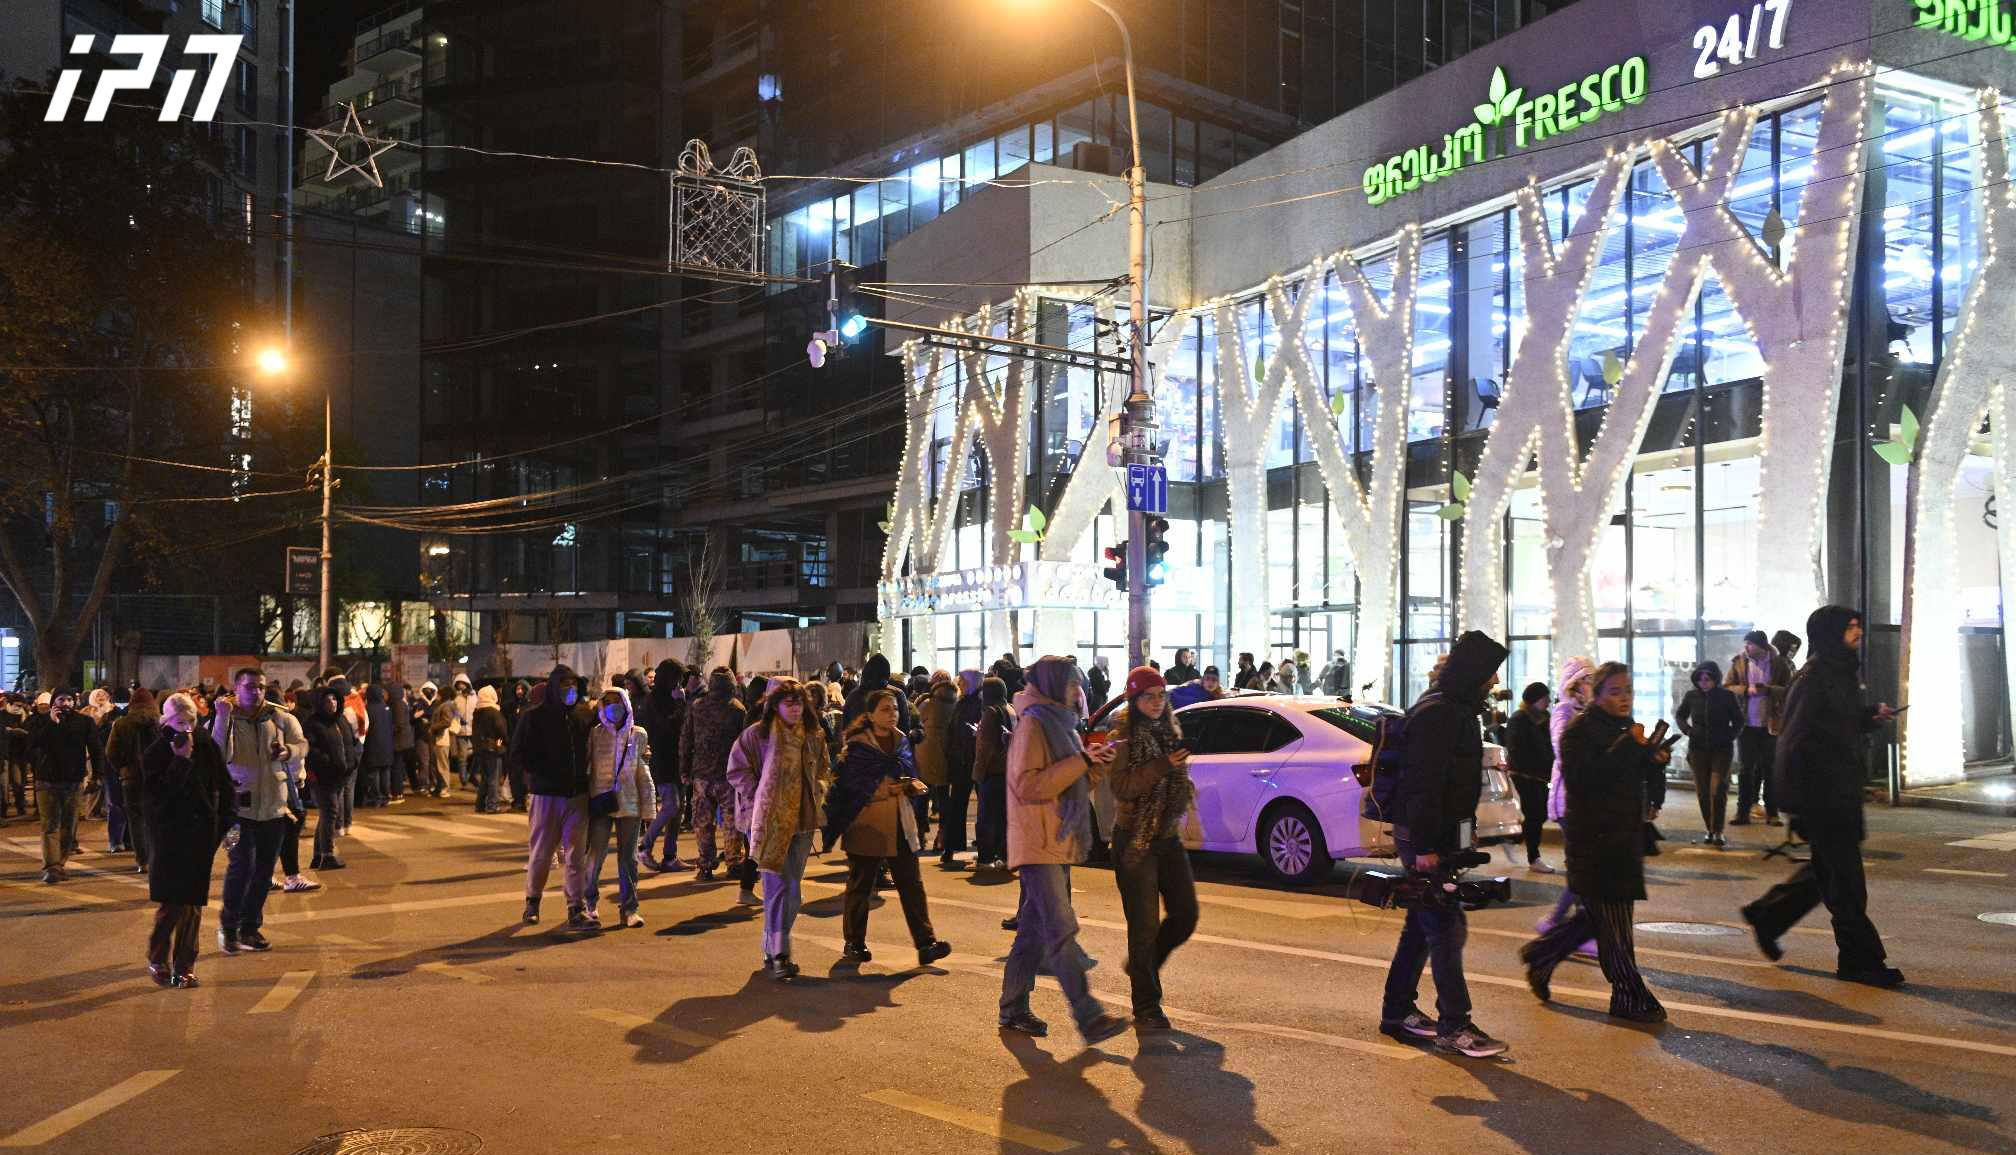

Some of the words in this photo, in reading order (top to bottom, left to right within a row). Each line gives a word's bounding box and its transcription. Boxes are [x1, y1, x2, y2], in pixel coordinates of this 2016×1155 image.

[1693, 0, 1792, 79] 24/7
[1514, 55, 1649, 149] FRESCO
[1362, 121, 1486, 206] ფრესკო
